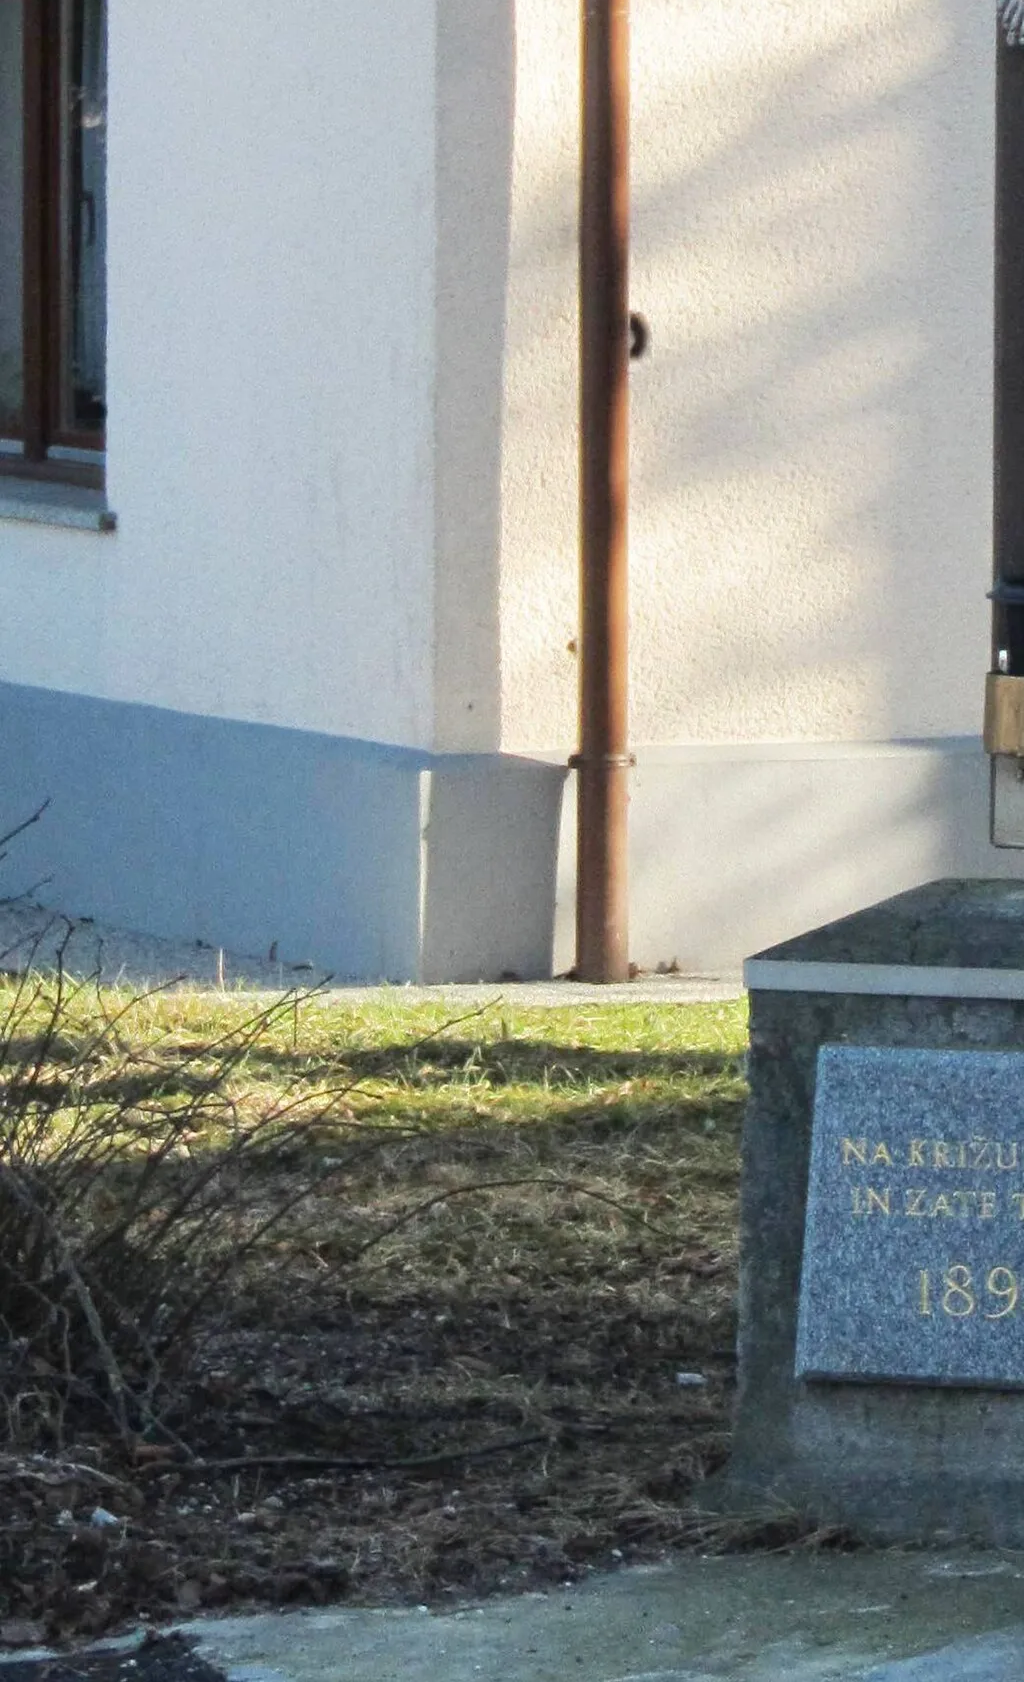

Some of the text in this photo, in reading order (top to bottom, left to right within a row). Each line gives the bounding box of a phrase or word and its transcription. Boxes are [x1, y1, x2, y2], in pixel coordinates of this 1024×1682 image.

[841, 1137, 893, 1166] NA
[907, 1134, 1018, 1169] KRIŽU
[851, 1186, 891, 1215] IN
[904, 1187, 996, 1219] ZATE
